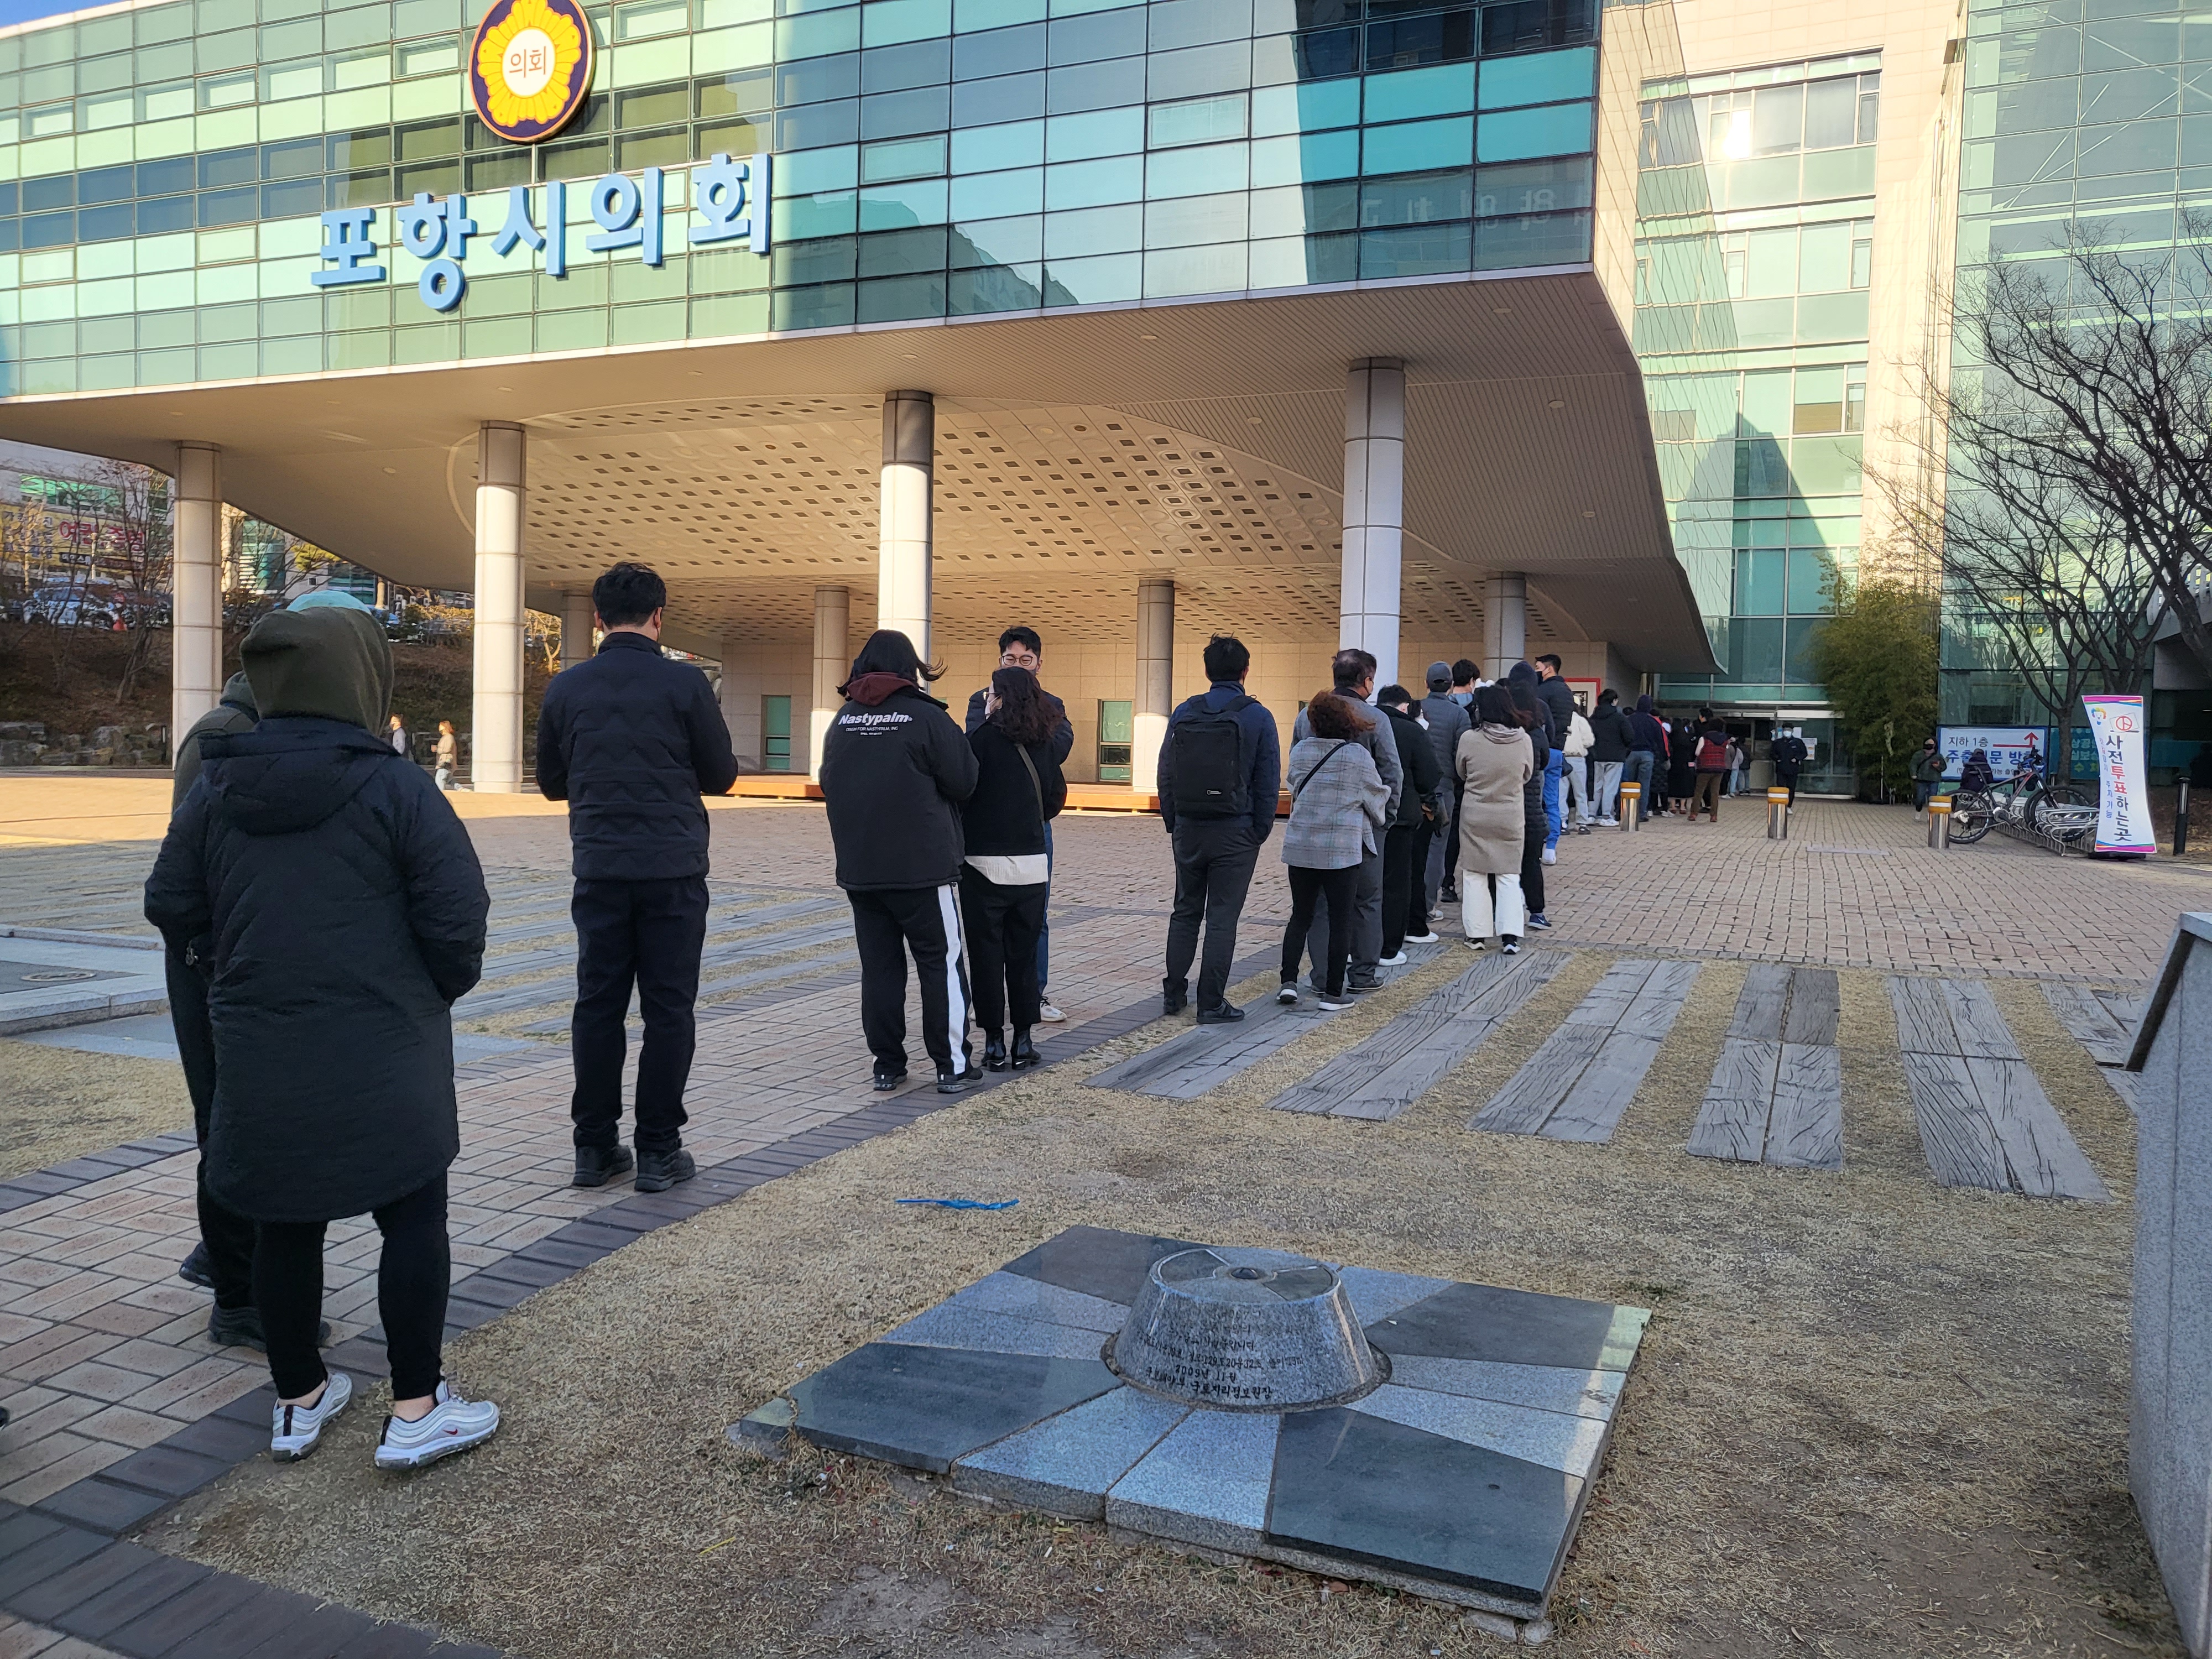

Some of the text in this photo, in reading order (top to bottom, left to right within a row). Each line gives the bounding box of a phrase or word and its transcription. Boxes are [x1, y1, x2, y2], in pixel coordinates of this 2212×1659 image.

[509, 46, 546, 78] 의회
[311, 153, 772, 310] 포항시의회
[1949, 737, 1989, 747] 지하 1층
[2105, 735, 2132, 842] 사전투표하는곳
